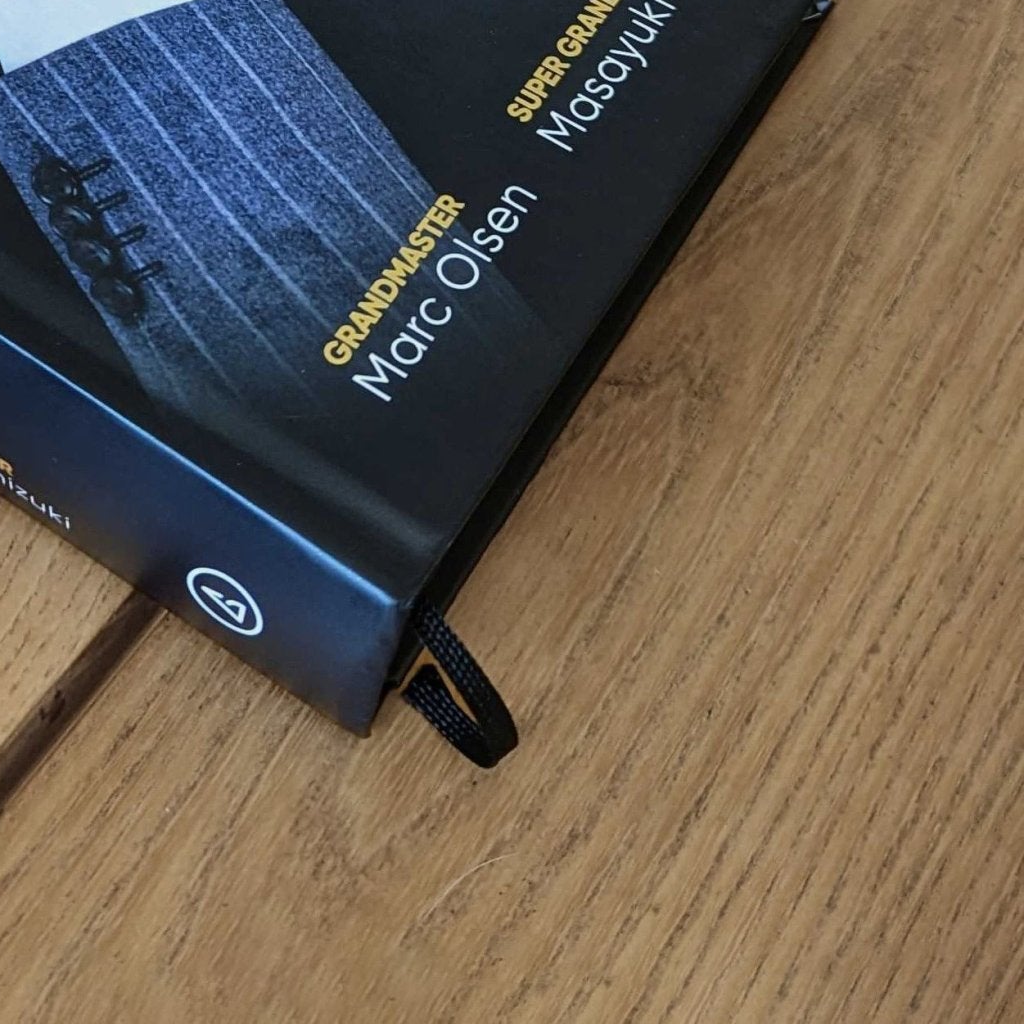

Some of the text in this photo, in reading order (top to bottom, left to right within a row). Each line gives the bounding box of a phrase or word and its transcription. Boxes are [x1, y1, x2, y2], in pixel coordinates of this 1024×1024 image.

[506, 55, 571, 124] SUPER
[322, 193, 466, 366] GRANDMASTER
[350, 183, 539, 403] Marc Olsen
